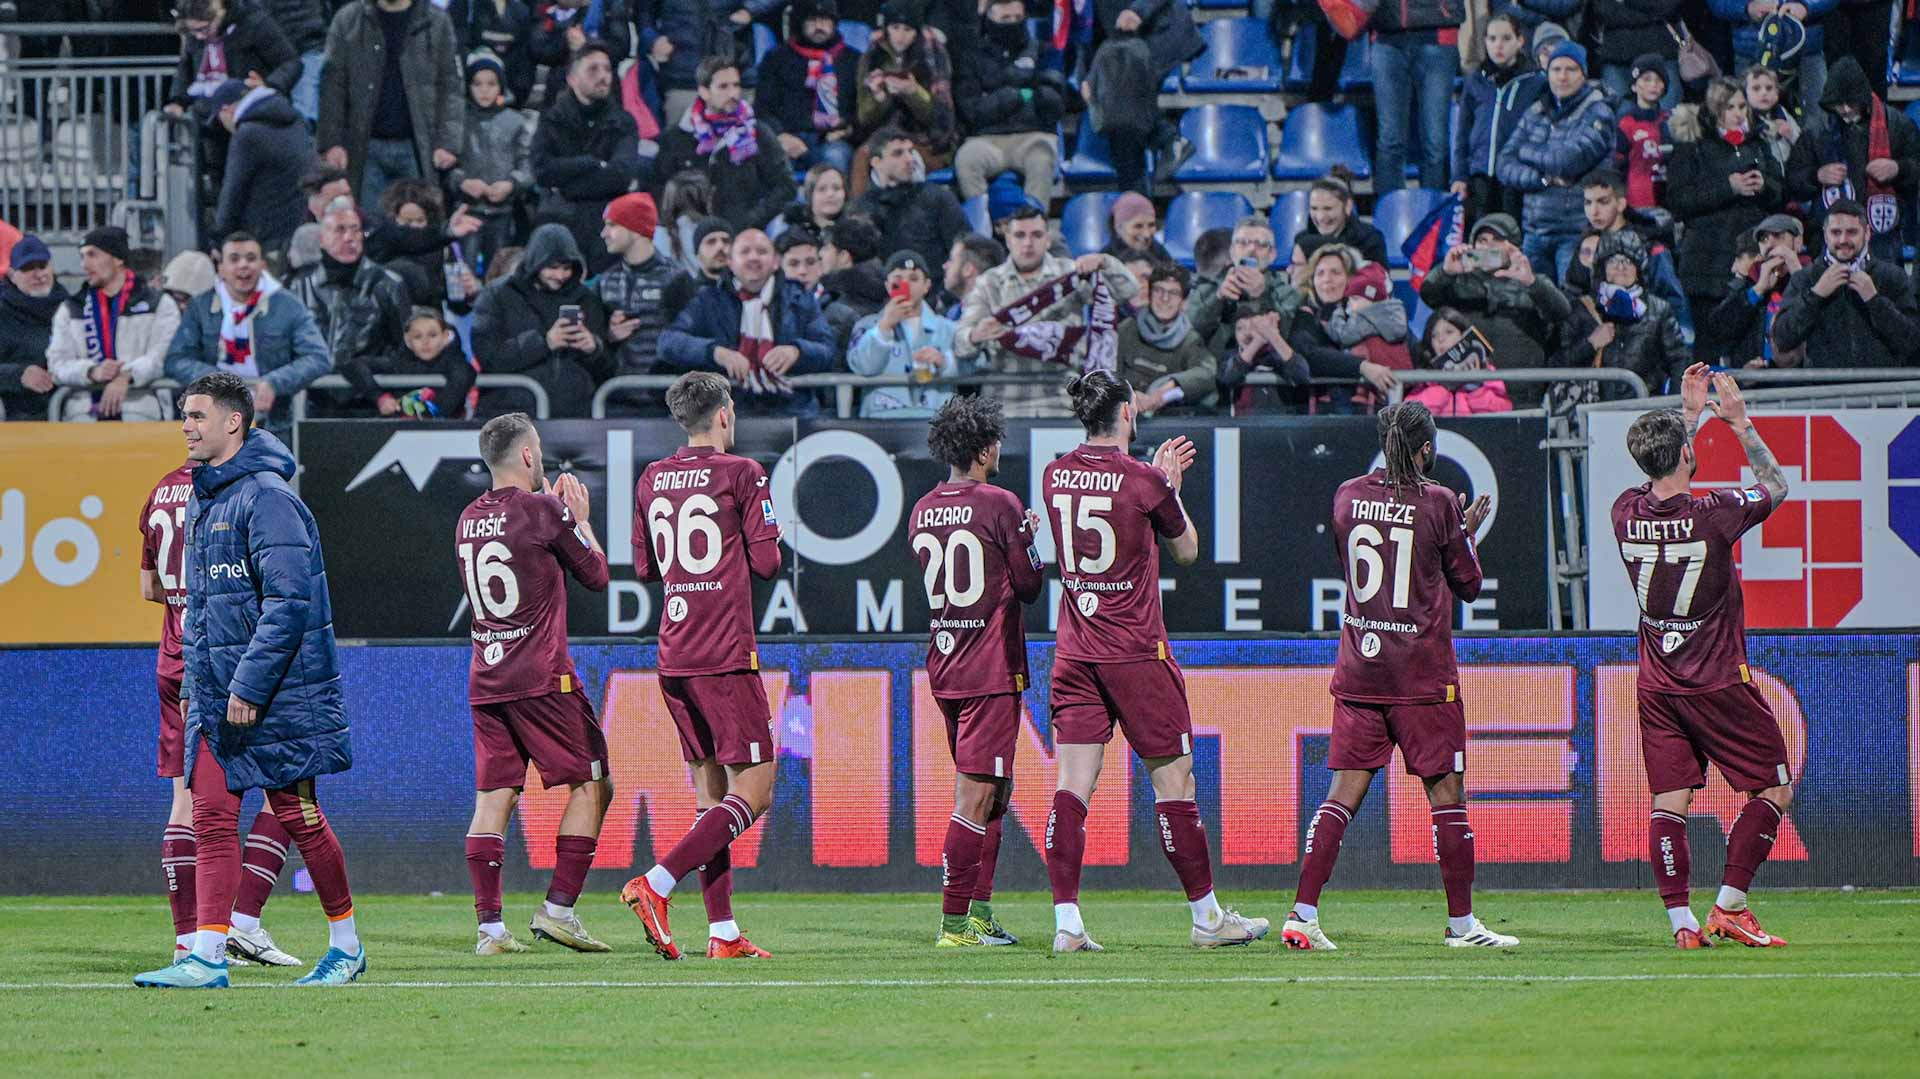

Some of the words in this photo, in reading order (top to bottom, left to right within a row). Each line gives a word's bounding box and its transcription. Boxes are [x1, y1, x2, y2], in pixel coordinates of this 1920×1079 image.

[653, 468, 711, 491] GINEITIS
[1051, 468, 1125, 492] SAZONOV
[462, 512, 507, 539] VLAŠIĆ
[648, 493, 723, 577] 66
[917, 505, 972, 529] LAZARO
[1052, 493, 1117, 575] 15
[1626, 519, 1694, 540] LINETTY
[209, 558, 249, 580] enel
[458, 541, 520, 621] 16
[911, 528, 986, 610] 20
[1347, 524, 1414, 610] 61
[1621, 540, 1708, 617] 77
